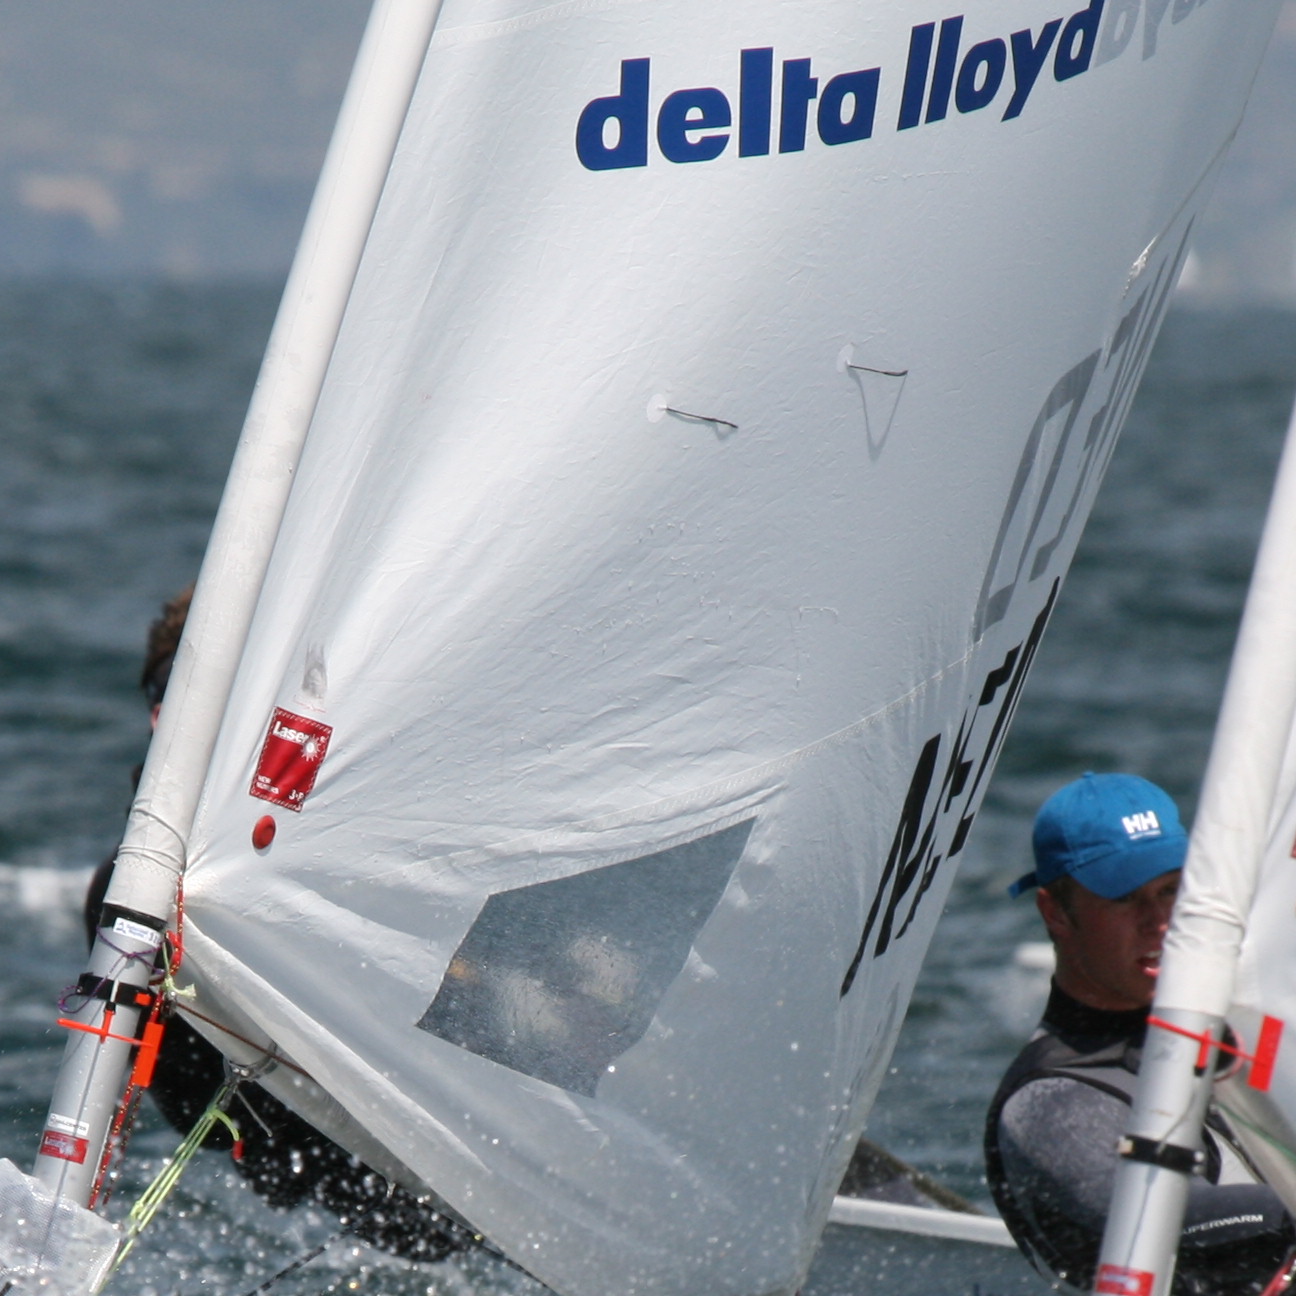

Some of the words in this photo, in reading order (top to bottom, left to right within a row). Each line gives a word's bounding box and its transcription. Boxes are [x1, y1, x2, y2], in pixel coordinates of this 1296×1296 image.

[576, 47, 881, 171] delta
[897, 0, 1103, 131] lloyd
[273, 721, 310, 745] Laser
[1122, 810, 1159, 834] HH
